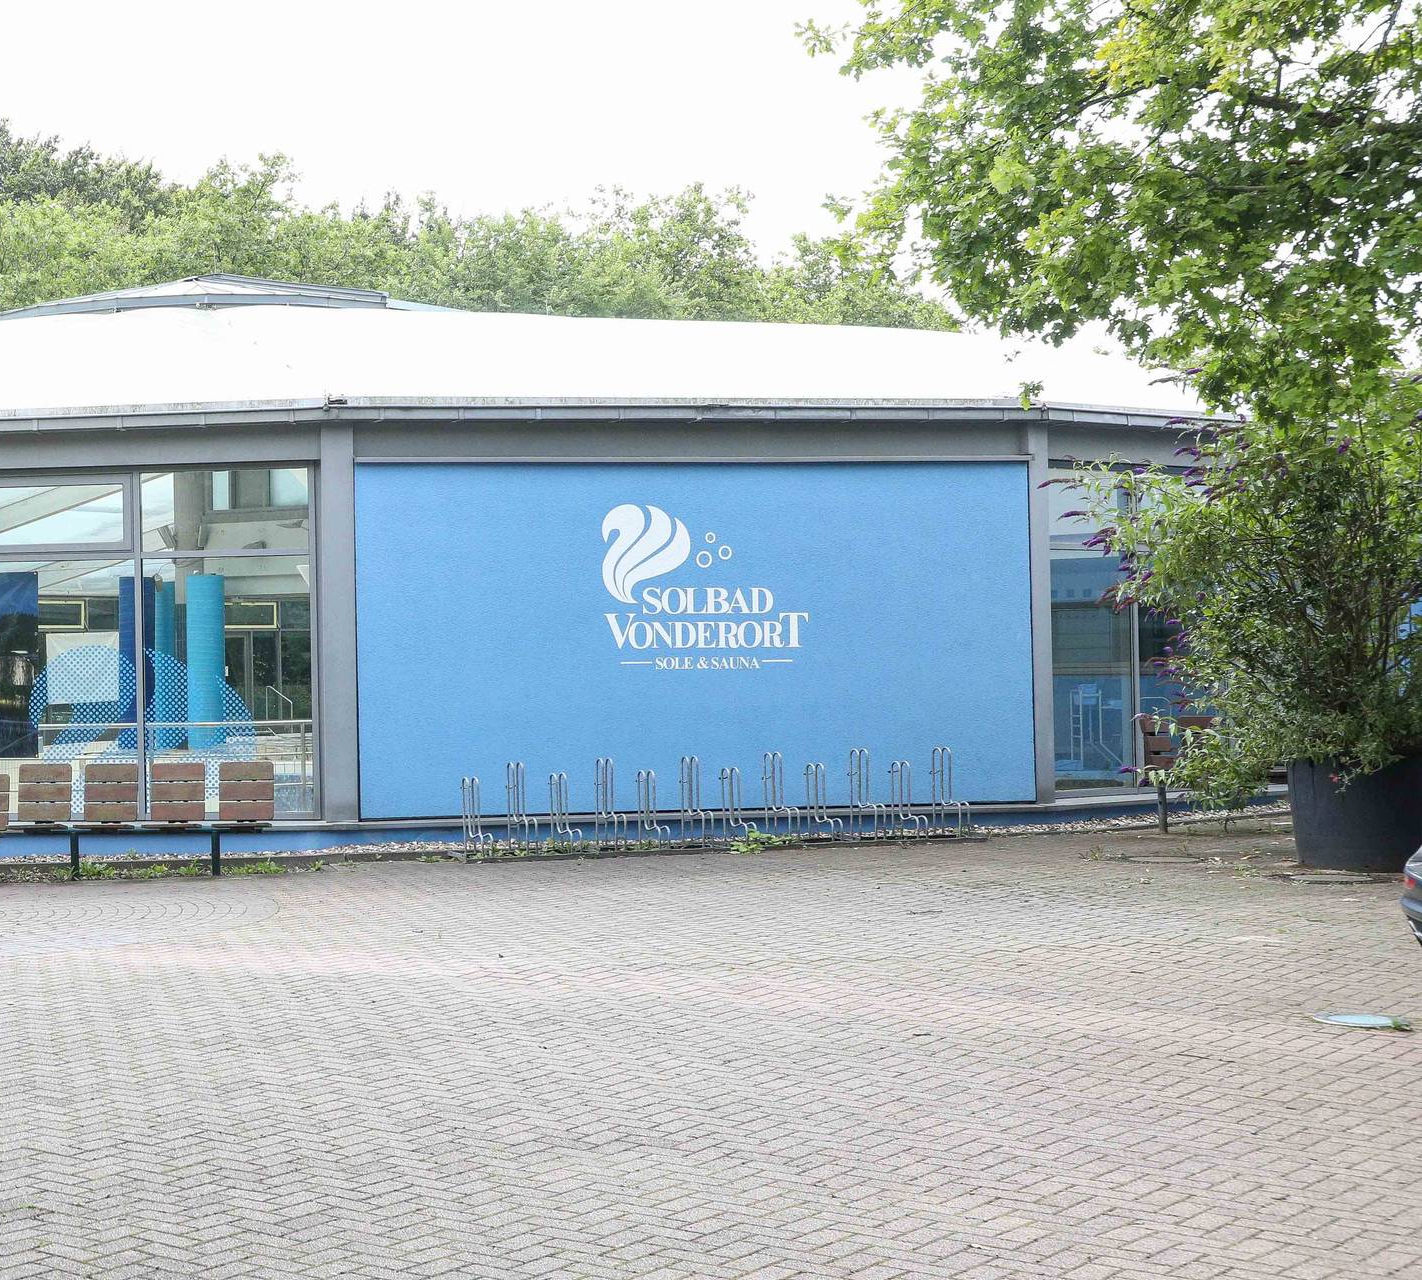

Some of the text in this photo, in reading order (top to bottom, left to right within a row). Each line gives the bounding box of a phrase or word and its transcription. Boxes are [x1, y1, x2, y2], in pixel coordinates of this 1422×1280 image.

[642, 587, 773, 615] SOLBAD
[604, 612, 809, 649] VONDERORT
[655, 656, 760, 670] SOLE & SAUNA
